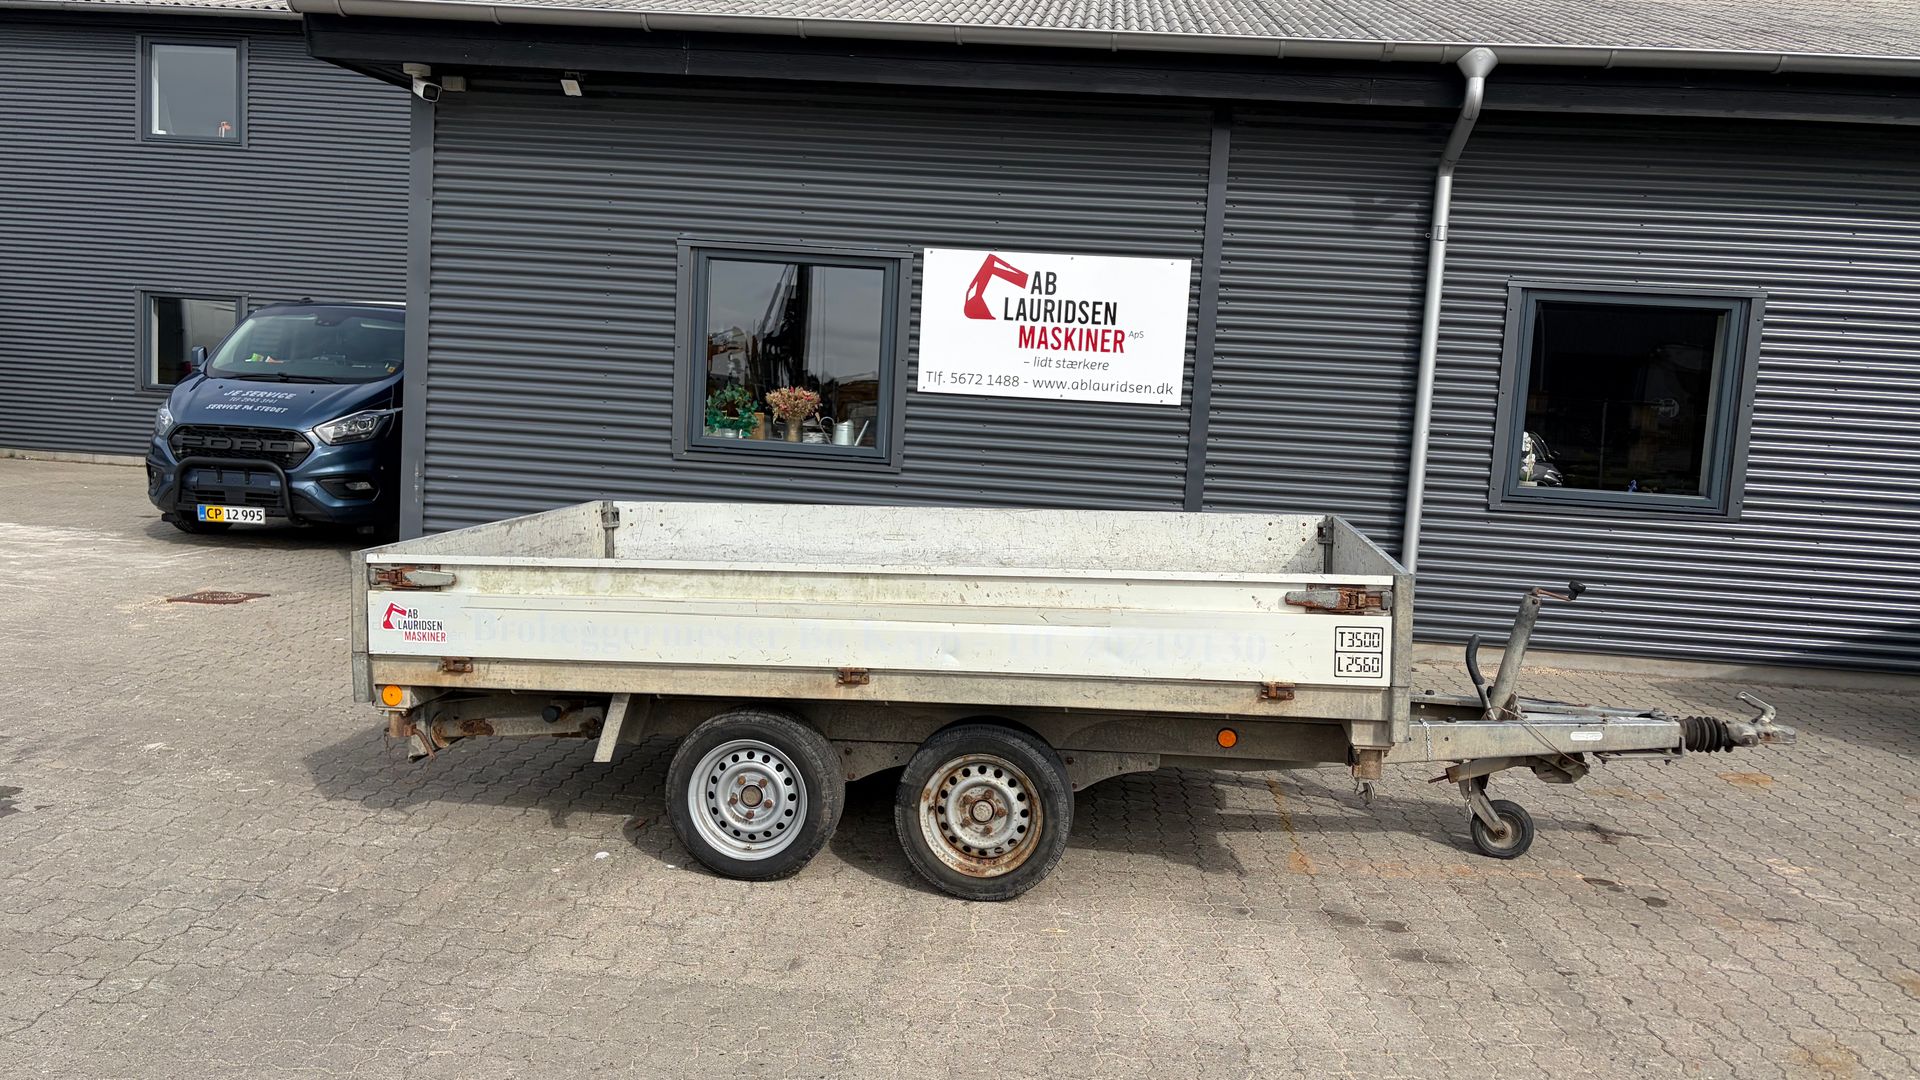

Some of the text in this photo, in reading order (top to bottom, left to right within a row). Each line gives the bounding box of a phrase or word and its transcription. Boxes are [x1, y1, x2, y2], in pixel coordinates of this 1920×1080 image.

[1030, 271, 1058, 295] AB
[1003, 297, 1118, 326] LAURIDSEN
[1018, 325, 1145, 353] MASKINER ApS
[1033, 356, 1053, 369] lidt
[1055, 358, 1110, 371] stærkere
[926, 371, 946, 386] Tlf.
[950, 372, 983, 386] 5672
[986, 374, 1020, 387] 1488
[1032, 377, 1174, 396] www.ablauridsen.dk
[241, 390, 297, 400] SERVICE
[254, 405, 288, 413] STEDET
[206, 508, 263, 521] CP 12 995
[407, 609, 418, 619] AB
[398, 620, 443, 631] LAURIDSEN
[404, 631, 446, 642] MASKINER
[1338, 631, 1381, 648] T3500
[1337, 656, 1380, 673] L2560
